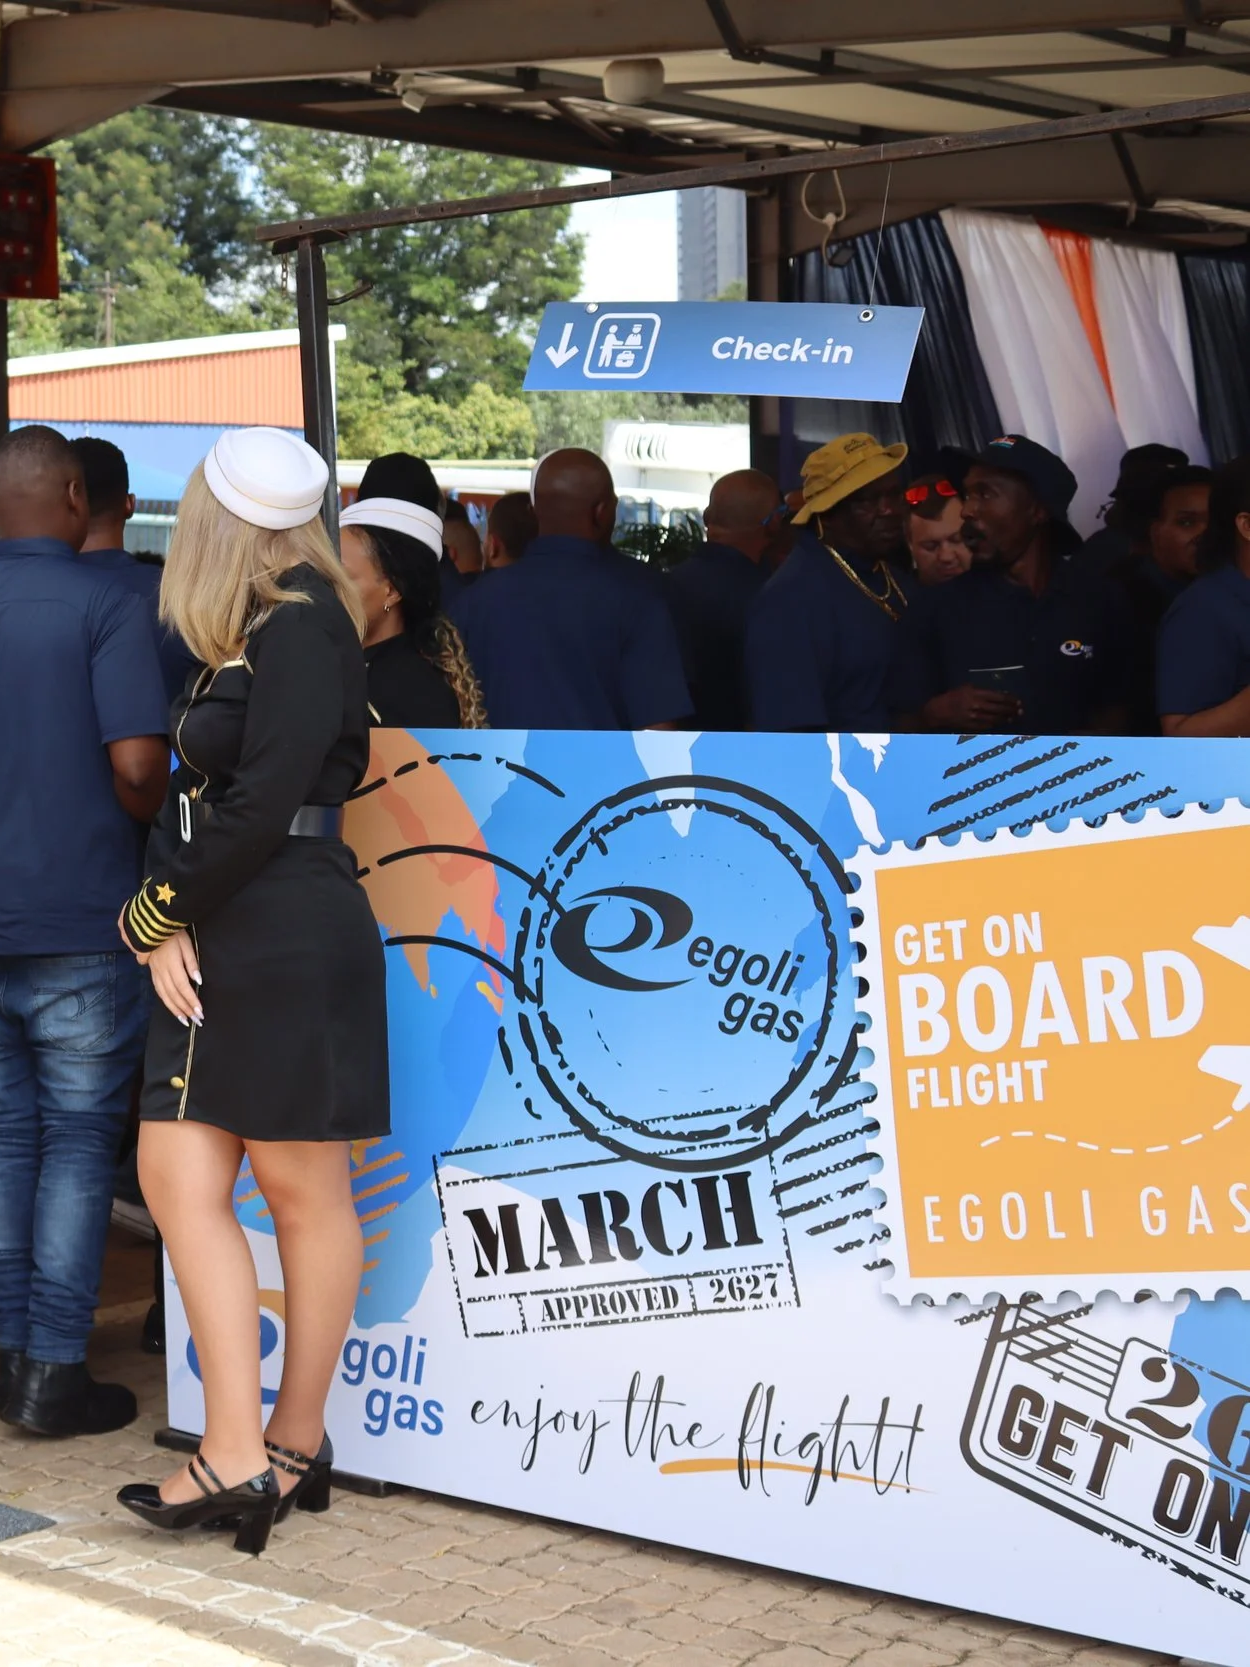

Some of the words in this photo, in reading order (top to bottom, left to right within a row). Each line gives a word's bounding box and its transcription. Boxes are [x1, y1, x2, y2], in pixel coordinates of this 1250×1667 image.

[712, 336, 853, 364] Check-in
[688, 936, 805, 997] egoli
[894, 919, 967, 966] GET
[982, 911, 1043, 957] ON
[718, 992, 803, 1043] gas
[898, 950, 1204, 1057] BOARD
[907, 1059, 1048, 1109] FLIGHT
[463, 1171, 763, 1278] MARCH
[924, 1189, 1094, 1242] EGOLI
[1139, 1182, 1250, 1236] GAS
[541, 1284, 679, 1323] APPROVED
[709, 1272, 779, 1304] 2627
[364, 1388, 444, 1437] gas
[470, 1385, 610, 1475] enjoy
[598, 1370, 725, 1463] the
[737, 1382, 925, 1506] flight!
[997, 1384, 1133, 1500] GET
[1152, 1458, 1250, 1566] ON
